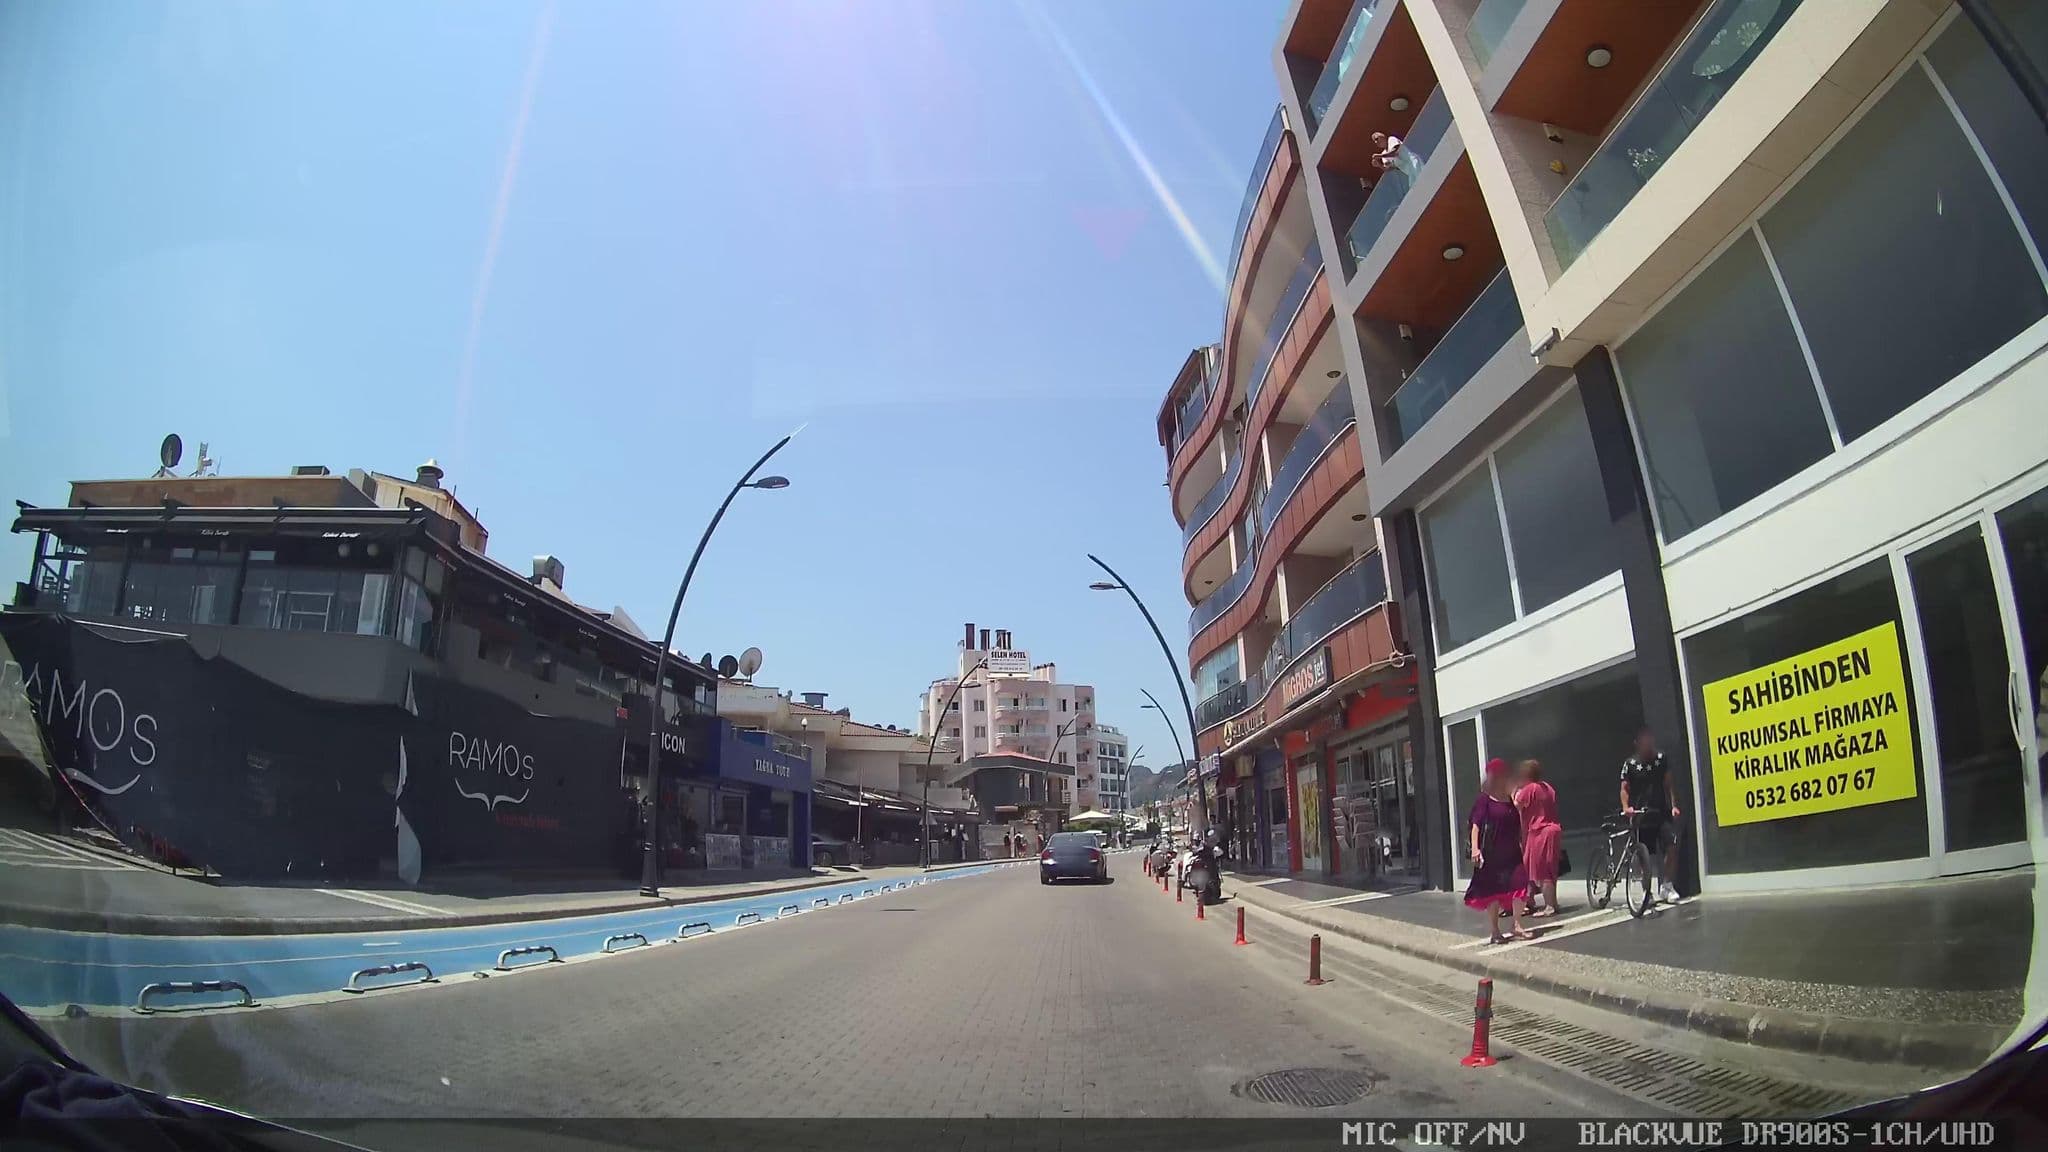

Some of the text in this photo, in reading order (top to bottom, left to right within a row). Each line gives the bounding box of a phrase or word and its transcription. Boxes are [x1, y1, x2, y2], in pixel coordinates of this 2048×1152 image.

[991, 651, 1026, 659] SELEN HOTEL
[1313, 656, 1325, 684] jet
[1728, 647, 1871, 714] SAHİBİNDEN
[661, 732, 686, 754] ICON
[1717, 691, 1898, 756] KURUMSAL FİRMAYA
[449, 731, 534, 780] RAMOS
[1734, 728, 1888, 780] KİRALIK MAĞAZA
[1745, 767, 1876, 809] 0532 682 07 67
